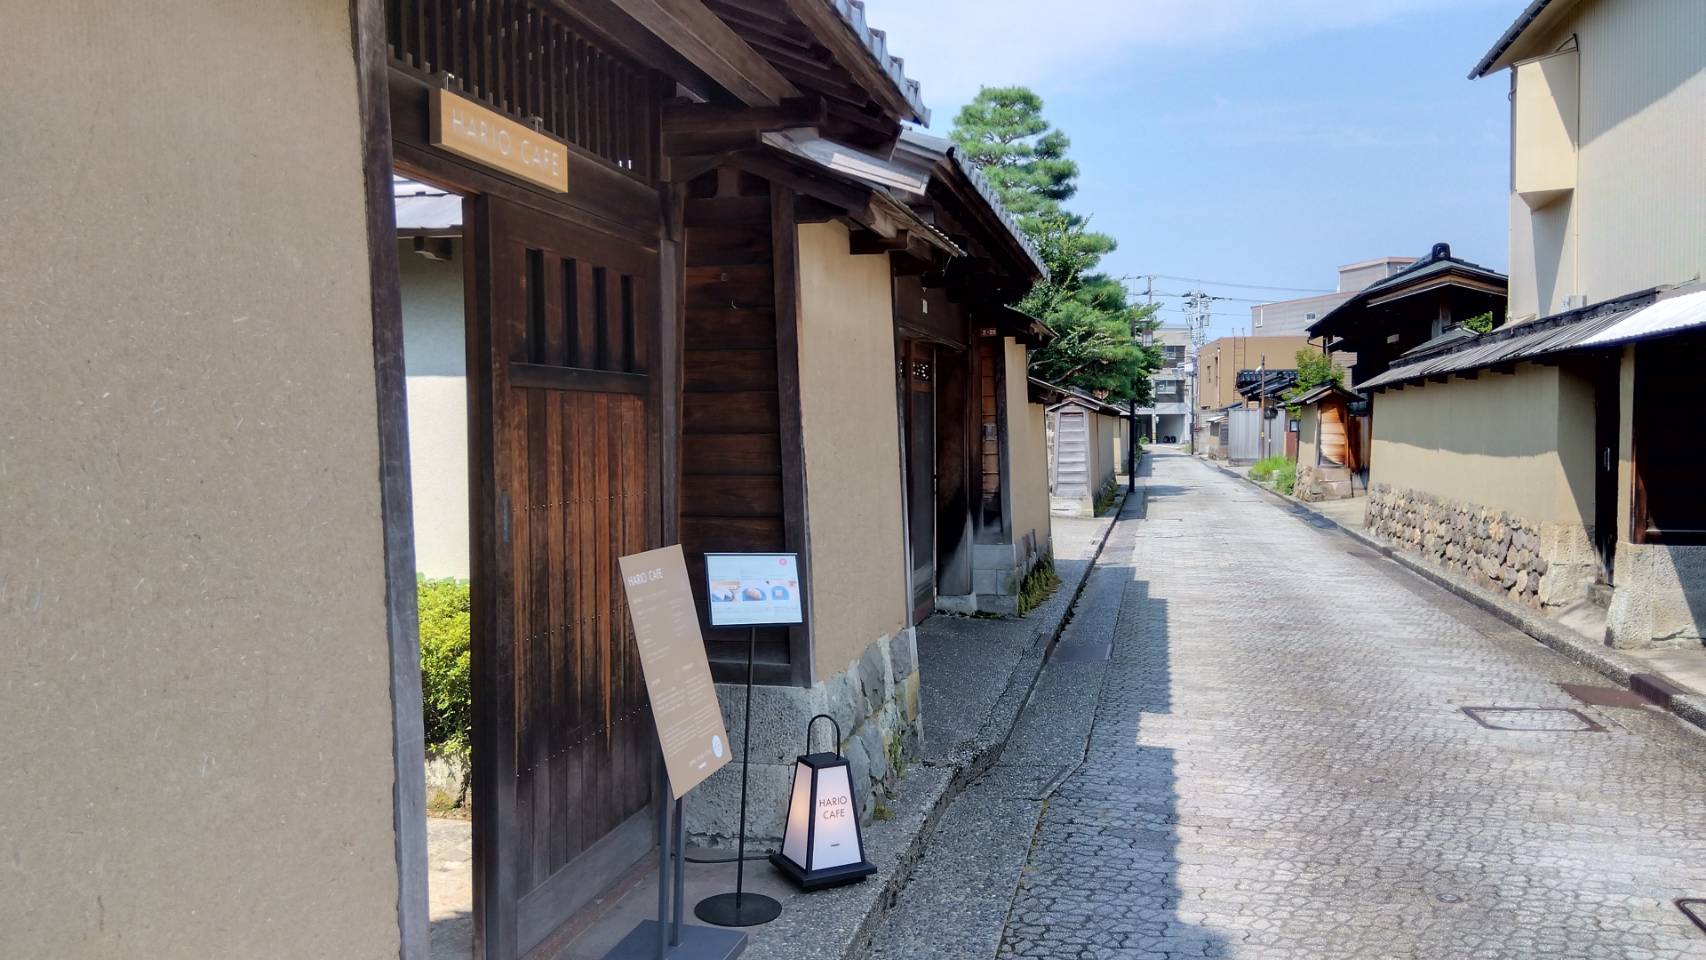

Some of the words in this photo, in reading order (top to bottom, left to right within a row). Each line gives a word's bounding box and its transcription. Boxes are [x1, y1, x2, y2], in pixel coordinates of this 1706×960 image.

[451, 108, 512, 156] HARIO
[520, 140, 560, 176] CAFE
[819, 796, 847, 807] HARIO
[823, 809, 845, 820] CAFE
